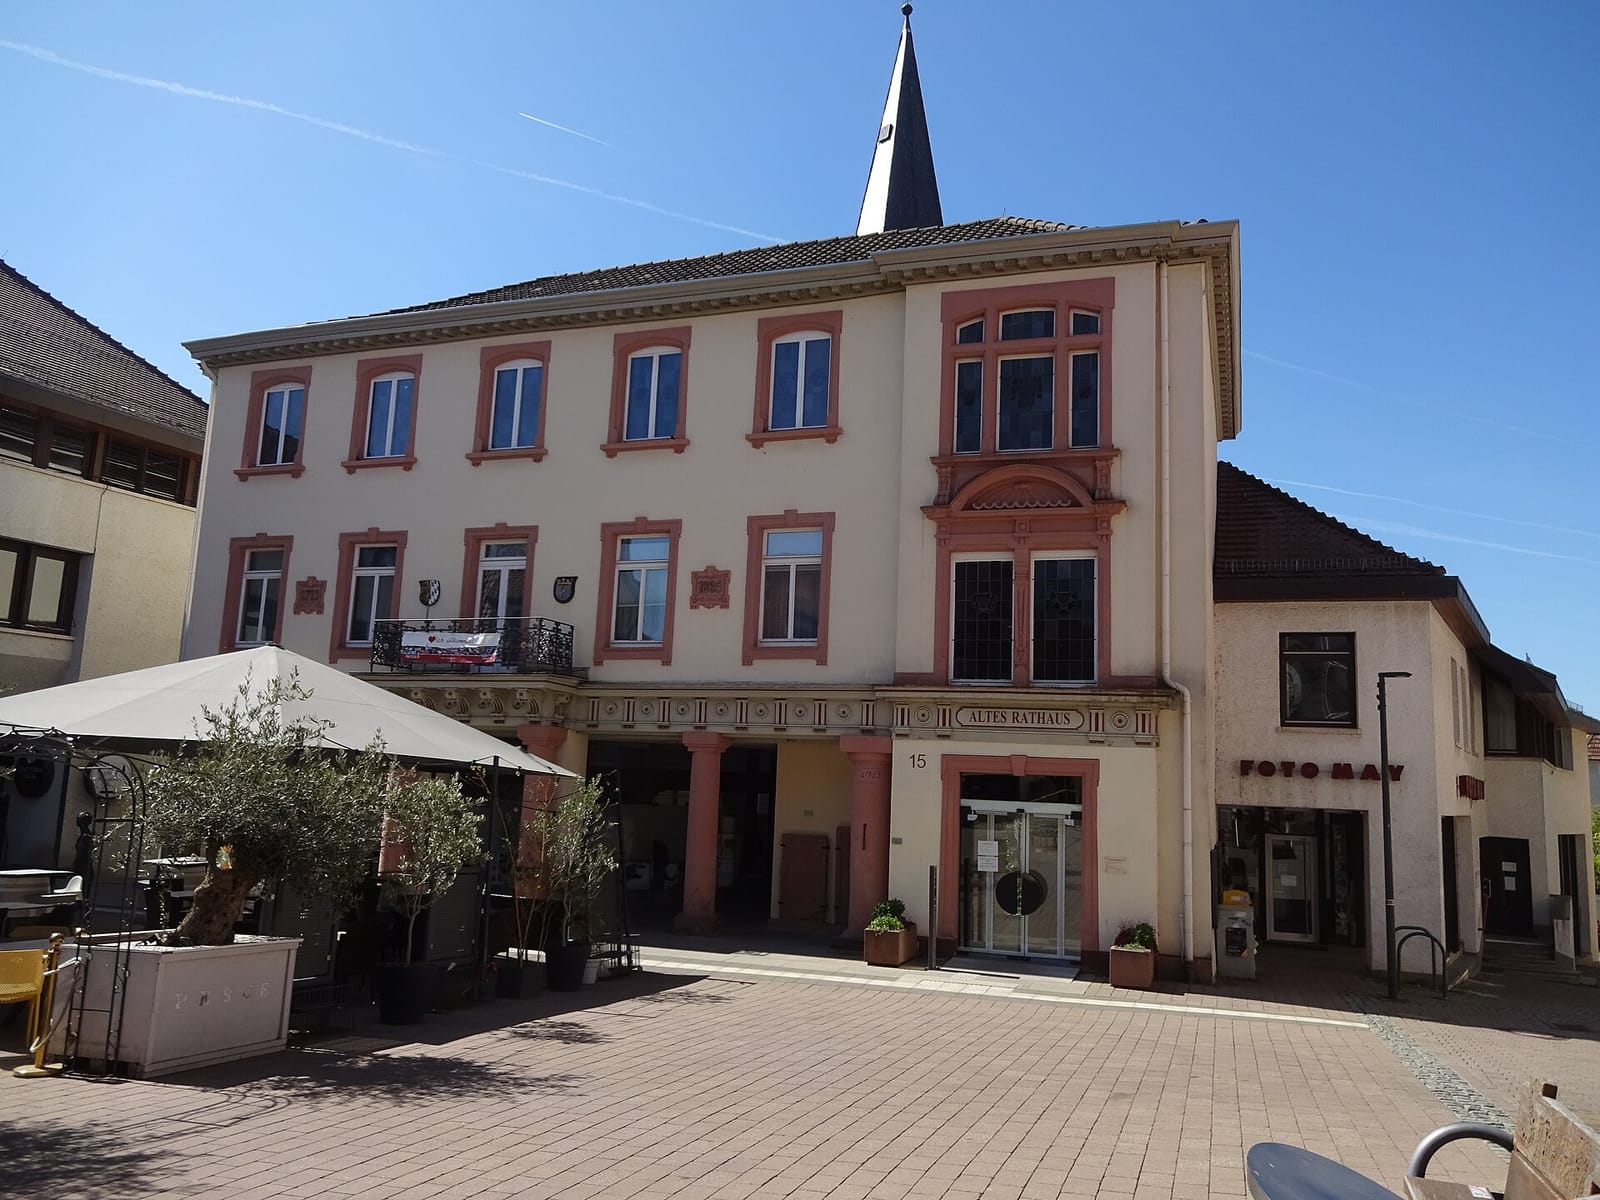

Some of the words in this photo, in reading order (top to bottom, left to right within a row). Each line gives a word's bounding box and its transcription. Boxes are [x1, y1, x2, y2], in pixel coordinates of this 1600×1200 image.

[969, 710, 1007, 724] ALTES
[1012, 711, 1071, 726] RATHAUS
[909, 753, 927, 769] 15
[1240, 760, 1320, 779] FOTO
[1331, 762, 1405, 781] MAY
